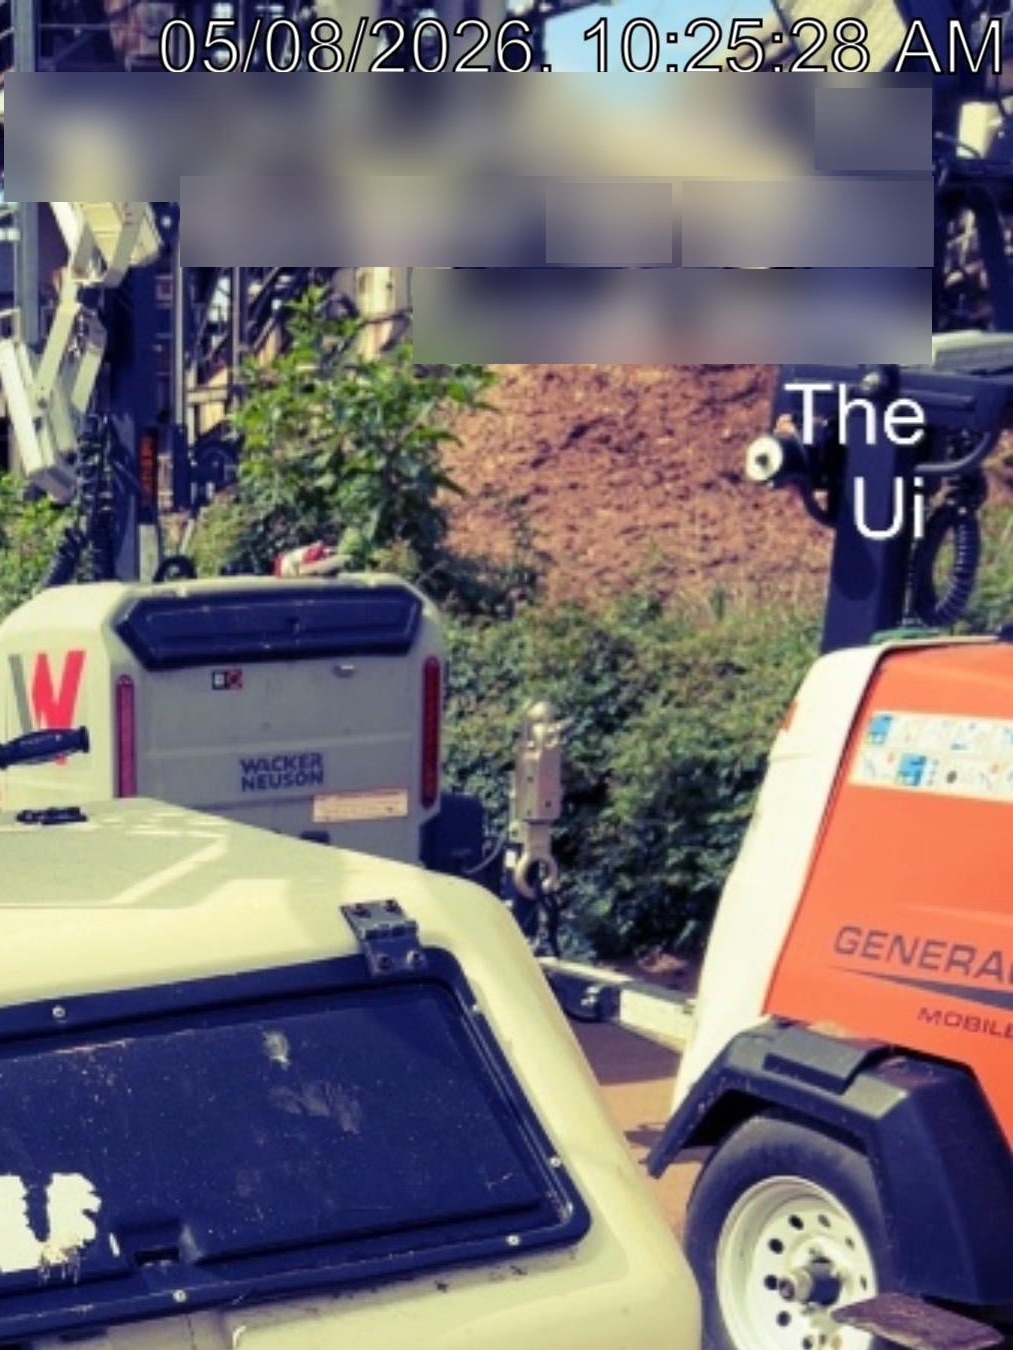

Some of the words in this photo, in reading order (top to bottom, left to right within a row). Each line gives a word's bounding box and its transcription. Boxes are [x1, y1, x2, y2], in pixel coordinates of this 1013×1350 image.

[240, 752, 323, 773] WACKER
[241, 770, 324, 792] NEUSON
[832, 925, 1013, 986] GENERA
